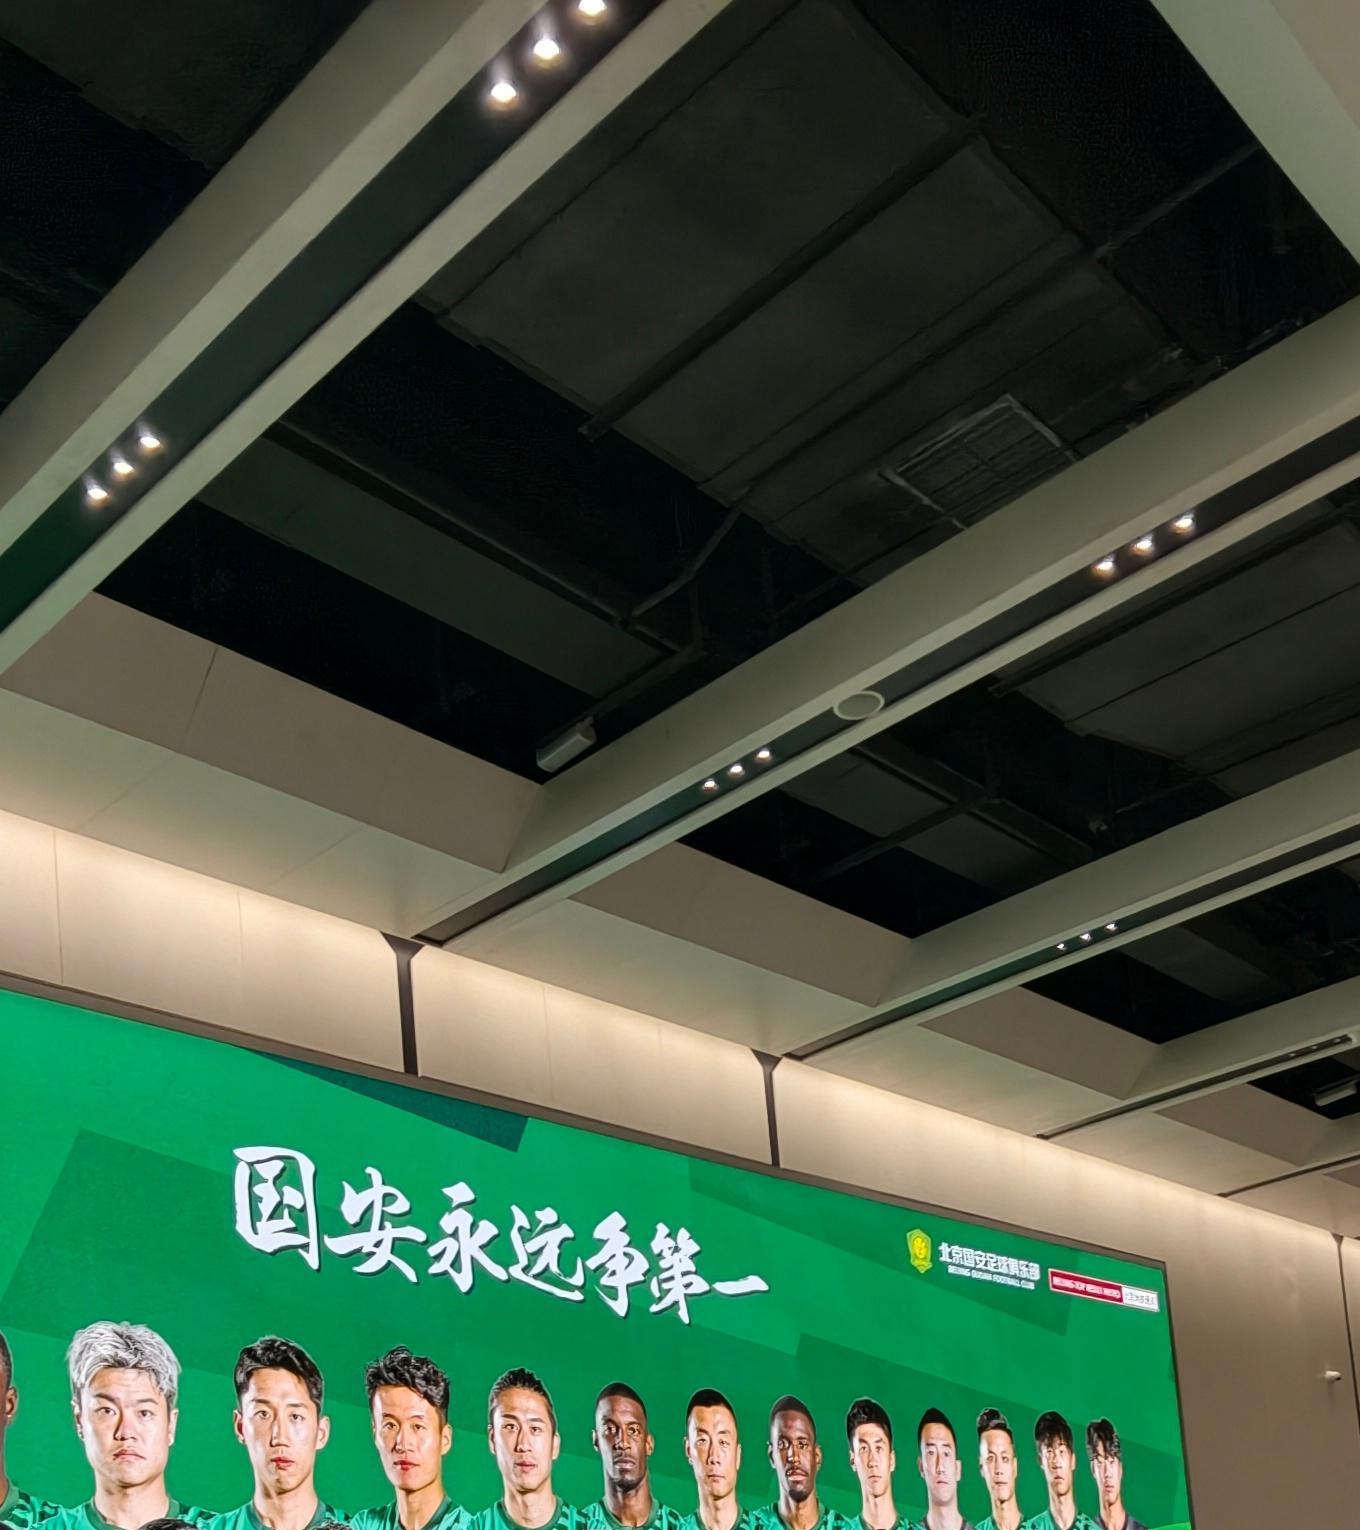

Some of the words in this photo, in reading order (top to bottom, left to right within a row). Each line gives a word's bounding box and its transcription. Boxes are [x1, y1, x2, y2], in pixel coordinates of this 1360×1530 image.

[233, 1146, 769, 1324] 国安永远争第一
